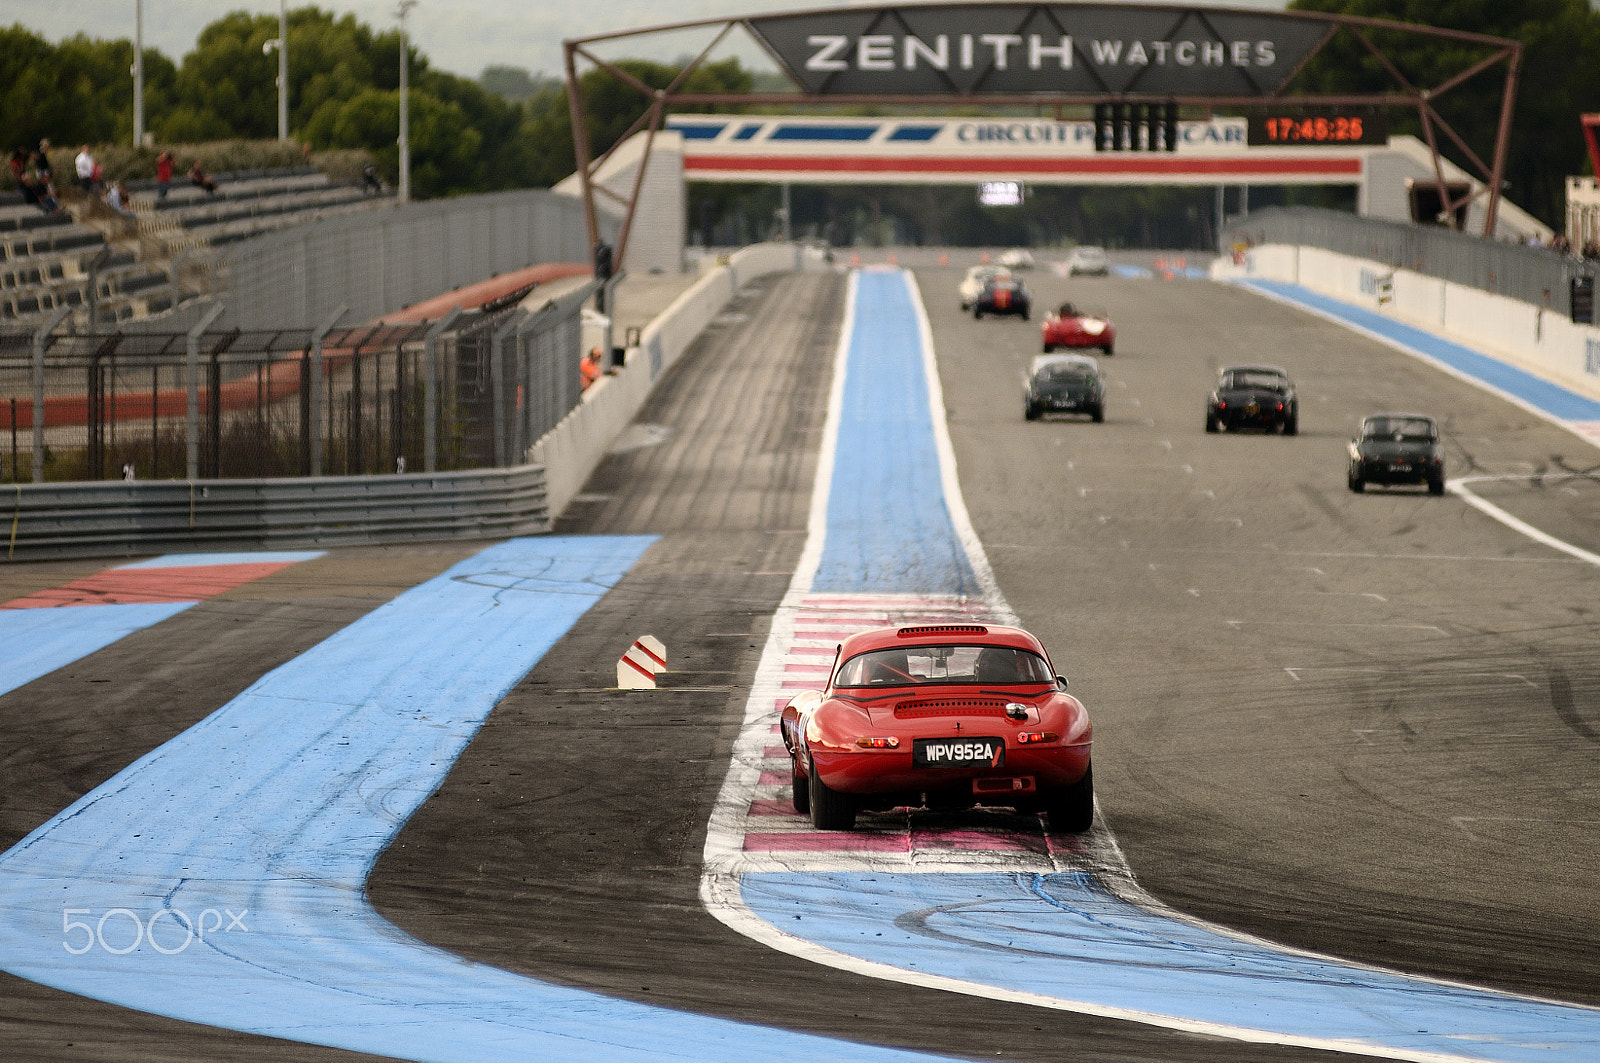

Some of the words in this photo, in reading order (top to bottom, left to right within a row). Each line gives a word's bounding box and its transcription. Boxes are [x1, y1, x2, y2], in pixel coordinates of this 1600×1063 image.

[806, 34, 1073, 70] ZENITH
[1091, 40, 1276, 66] WATCHES
[958, 123, 1066, 142] CIRCUIT
[926, 743, 993, 761] WPV952A
